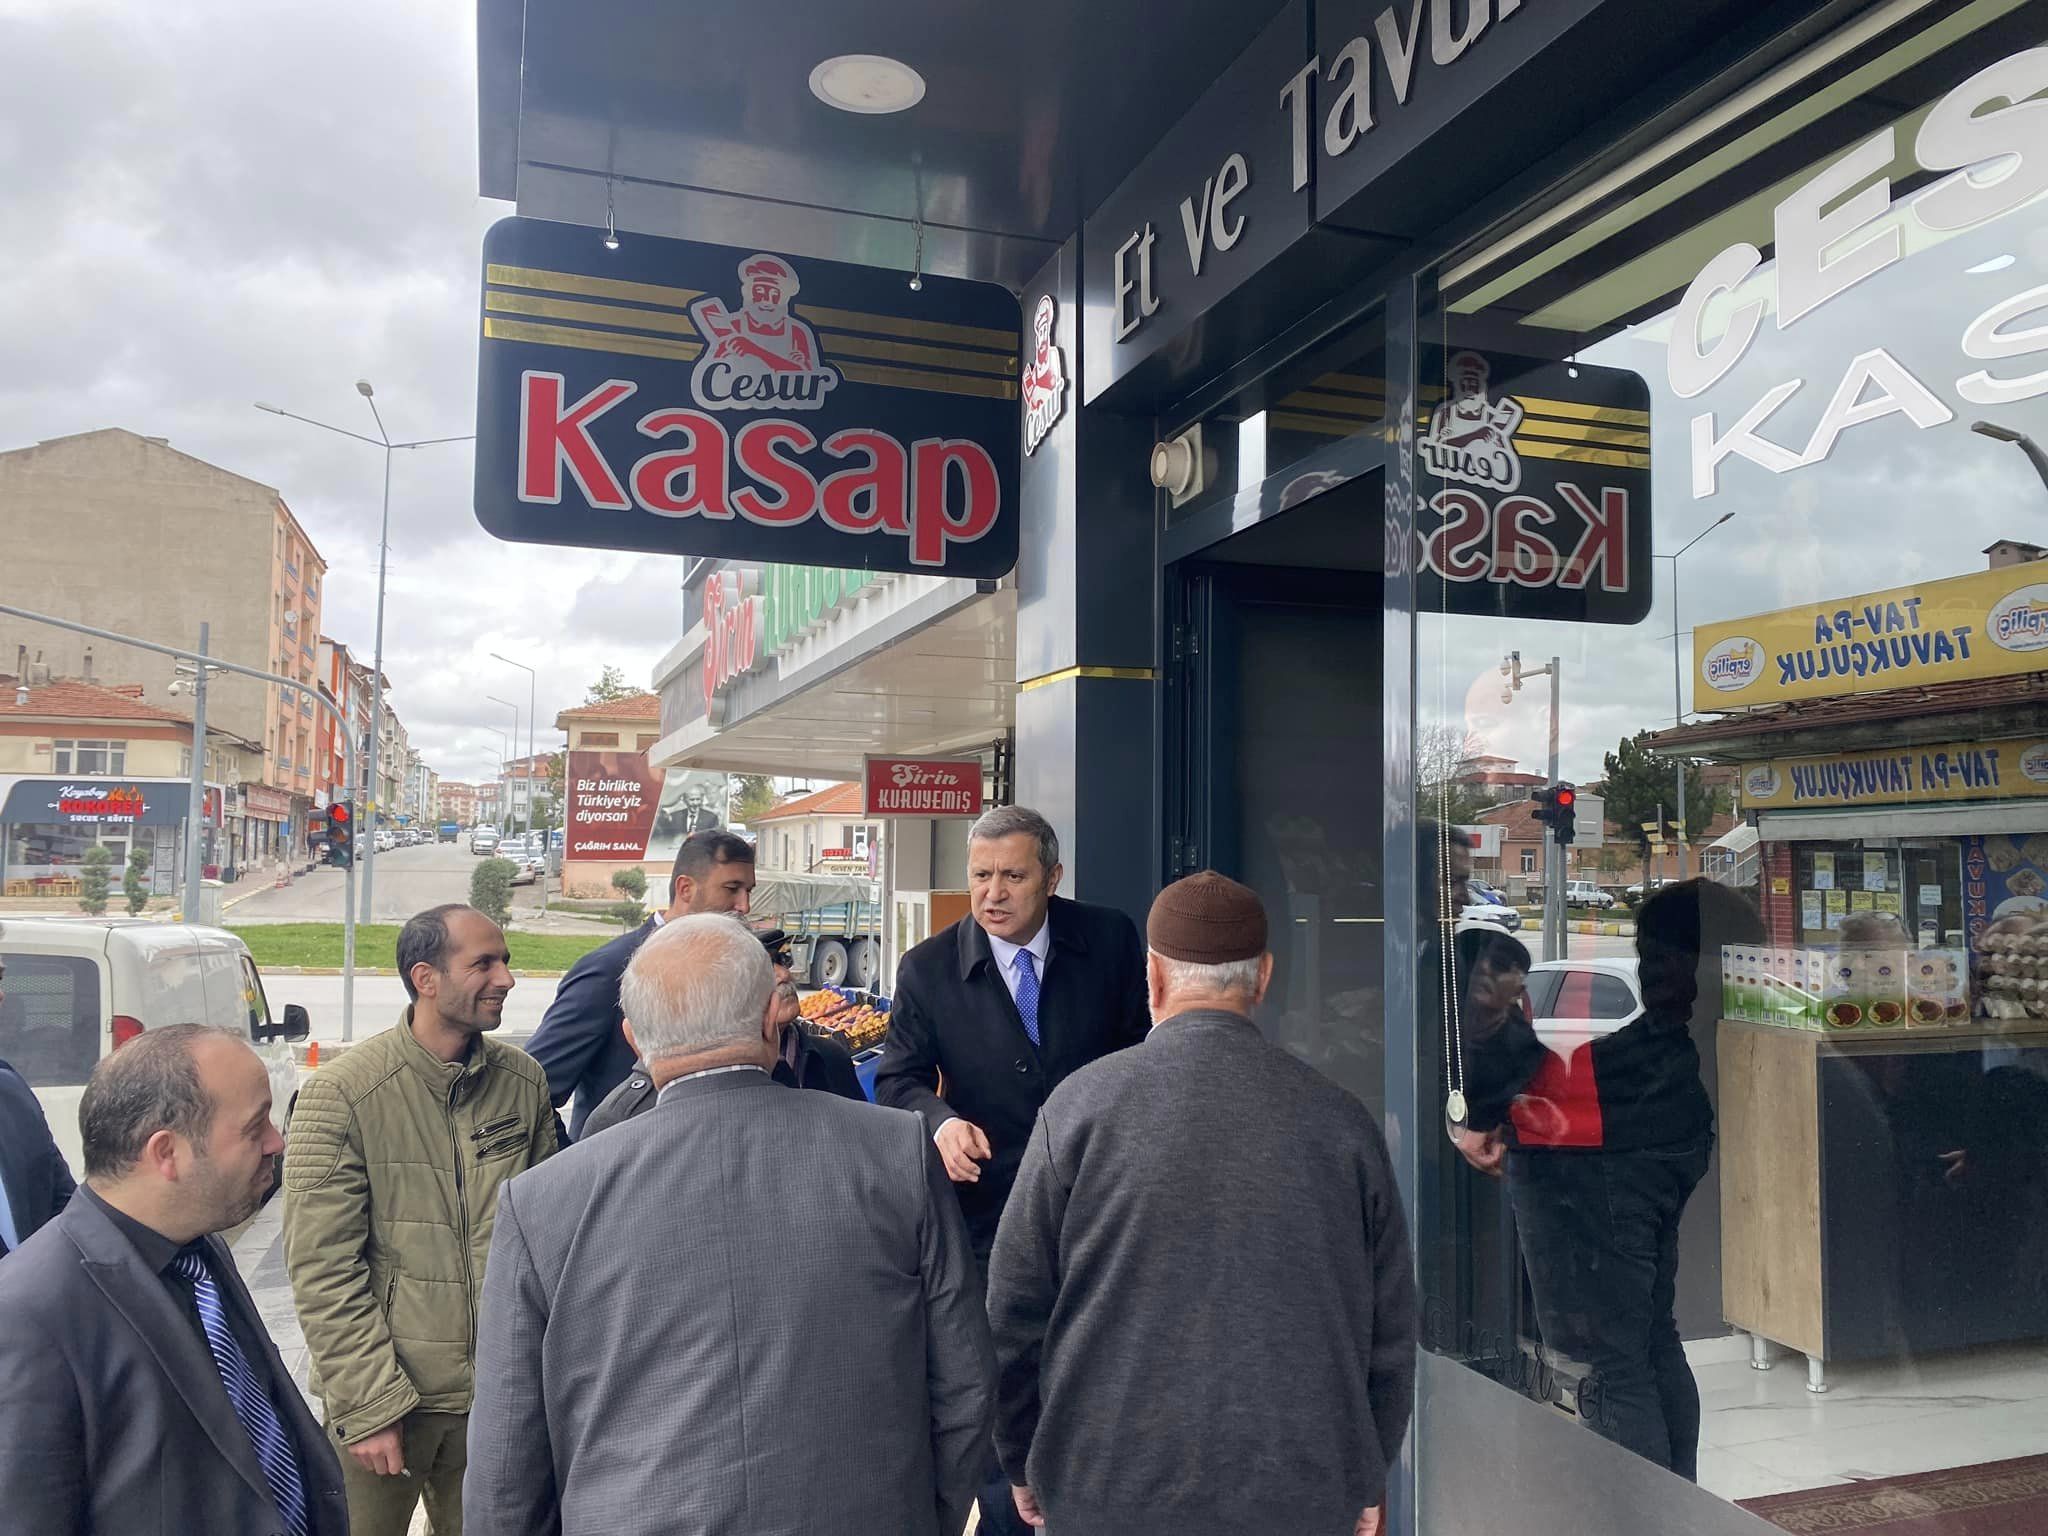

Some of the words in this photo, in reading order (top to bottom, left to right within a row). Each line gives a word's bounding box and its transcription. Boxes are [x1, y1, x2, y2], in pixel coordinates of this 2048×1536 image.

[1115, 221, 1160, 344] Et
[1179, 152, 1249, 277] ve
[1279, 0, 1520, 193] Tavu
[701, 361, 831, 402] Cesur
[1025, 380, 1063, 455] Cesur
[517, 369, 1001, 566] Kasap
[576, 779, 597, 792] Biz
[598, 779, 641, 792] birlikte
[890, 763, 960, 788] Şirin
[575, 809, 629, 824] diyorsan
